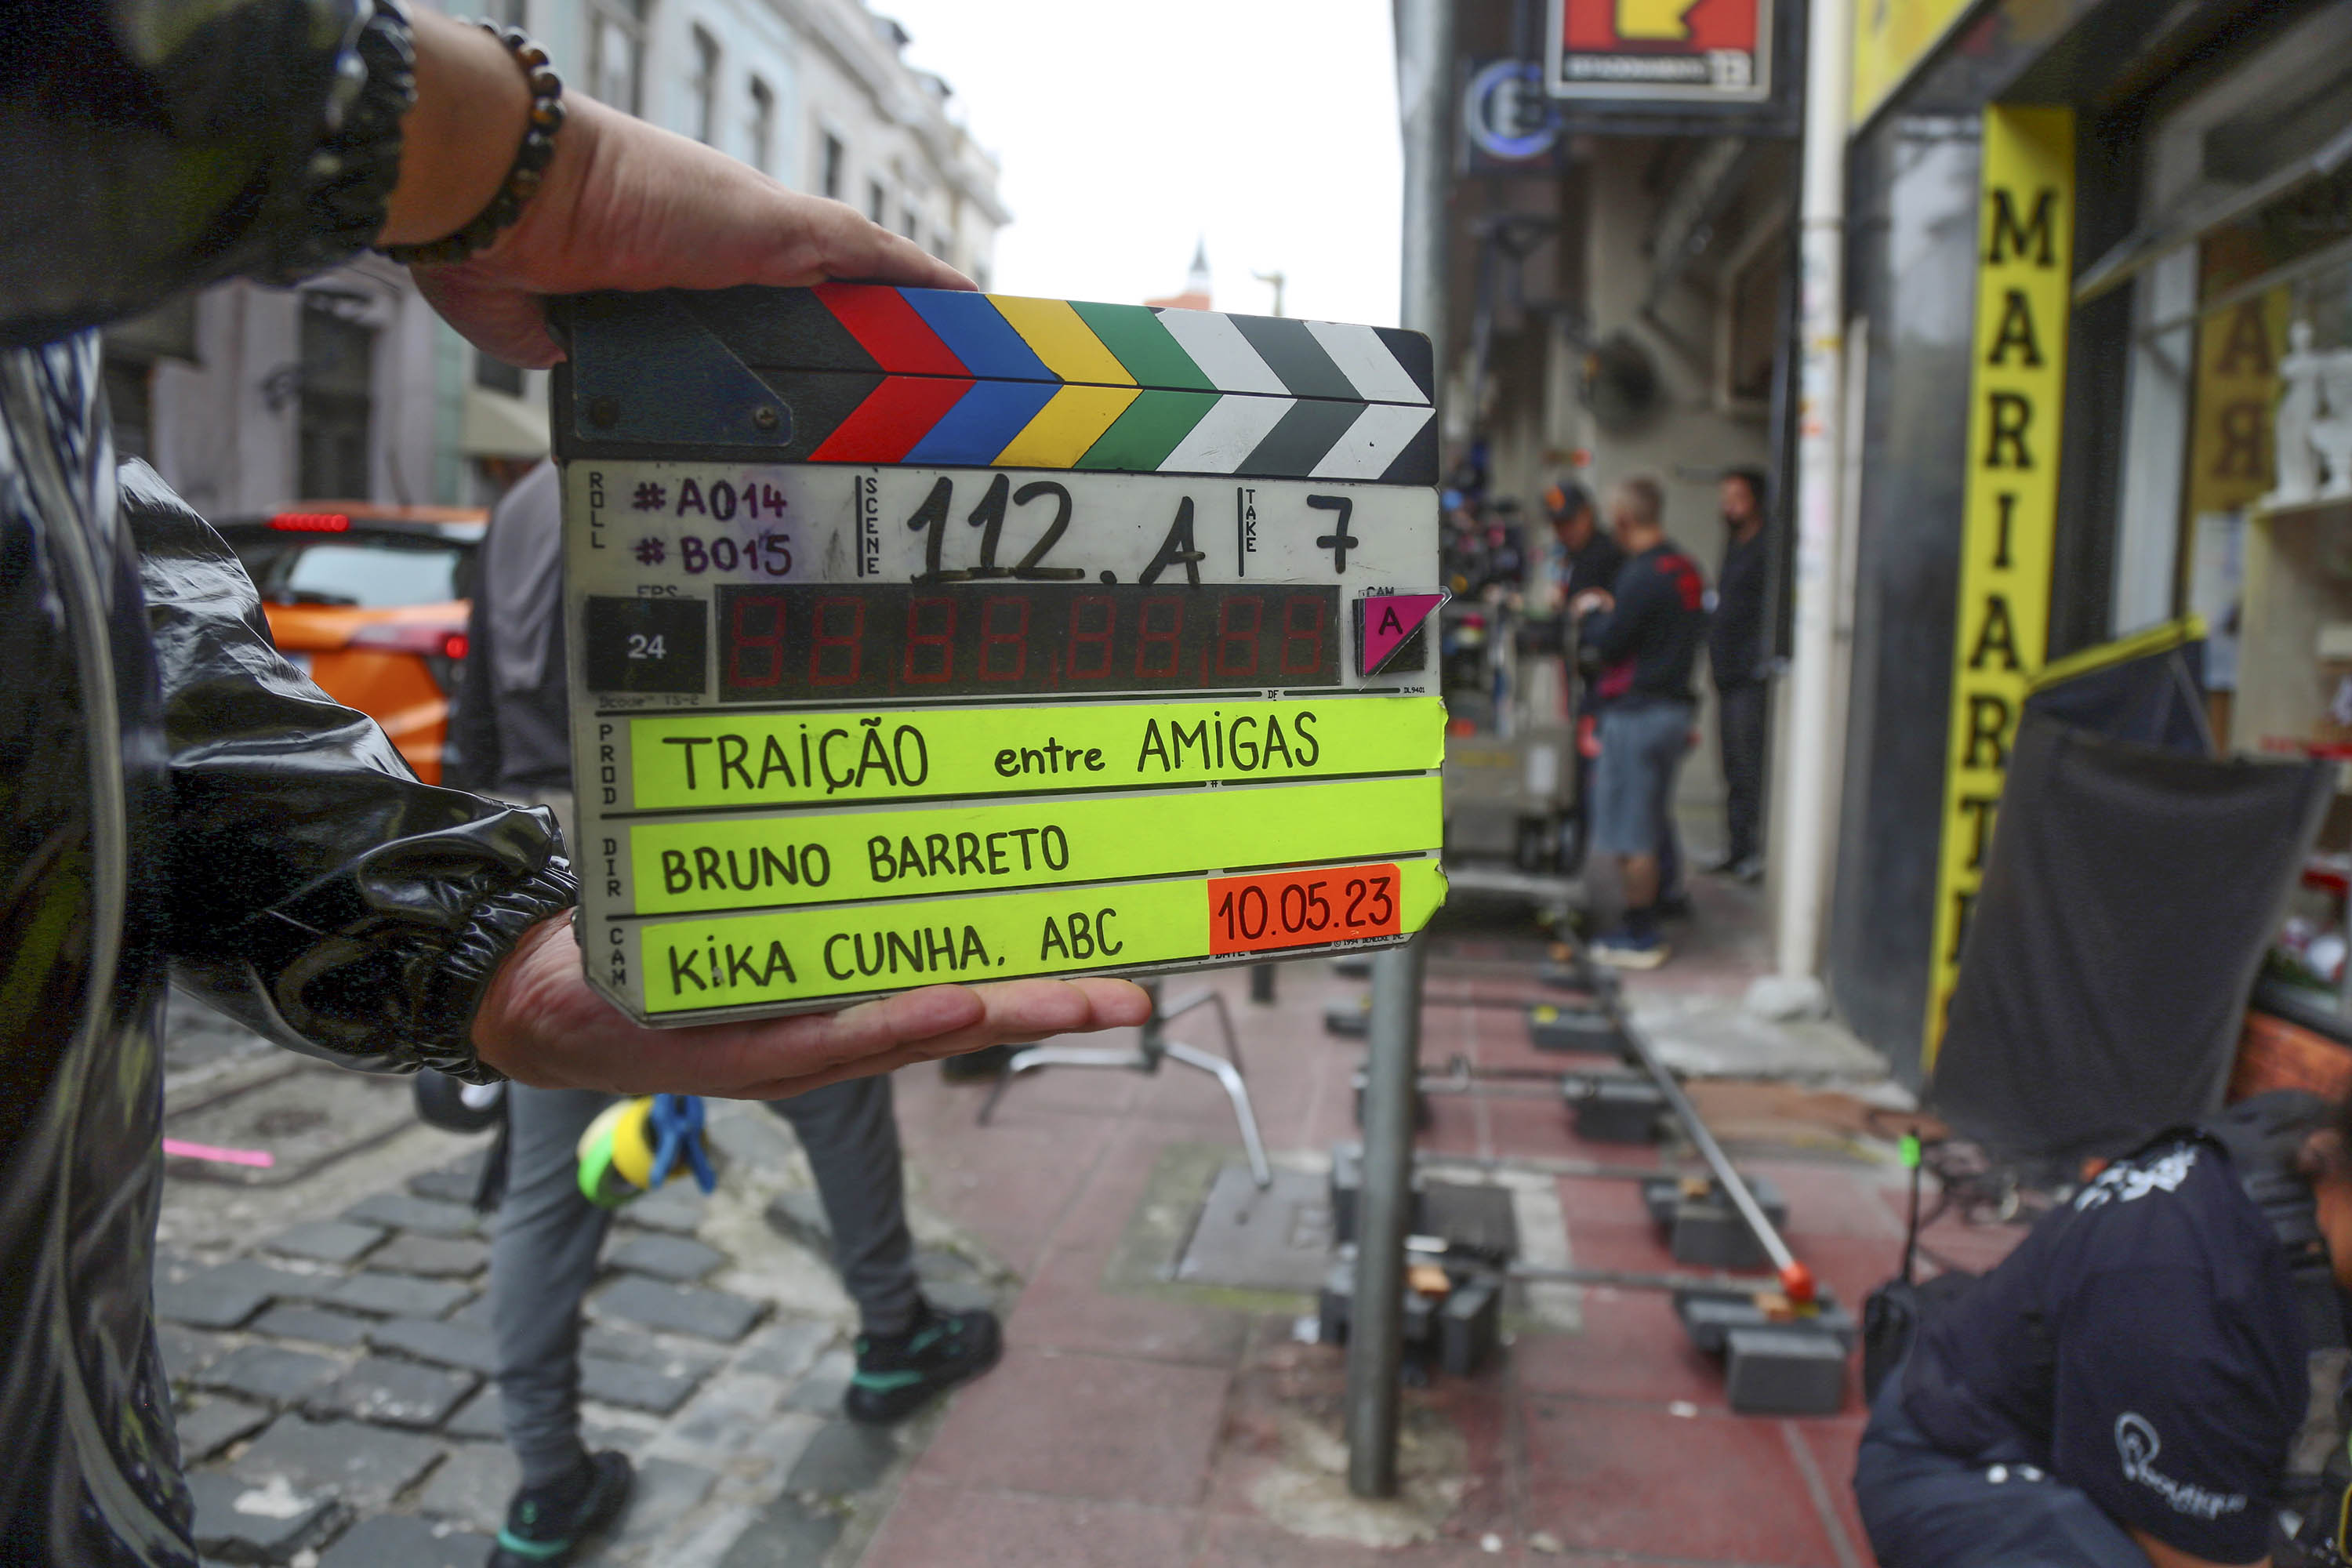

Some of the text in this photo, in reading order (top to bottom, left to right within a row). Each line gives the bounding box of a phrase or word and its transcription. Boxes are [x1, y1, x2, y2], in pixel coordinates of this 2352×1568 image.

[590, 471, 605, 549] ROLL
[865, 477, 880, 575] SCENE
[1245, 488, 1257, 553] TAKE
[1306, 493, 1359, 574] 7
[628, 634, 666, 659] 24
[1378, 606, 1403, 636] A
[1267, 690, 1279, 699] DF
[599, 724, 617, 805] PROD
[994, 736, 1105, 777] entre
[602, 839, 622, 897] DIR
[661, 825, 1070, 895] BRUNO BARRETO
[1040, 907, 1123, 961] ABC
[1217, 875, 1394, 942] 10.05.23
[609, 927, 626, 986] CAM
